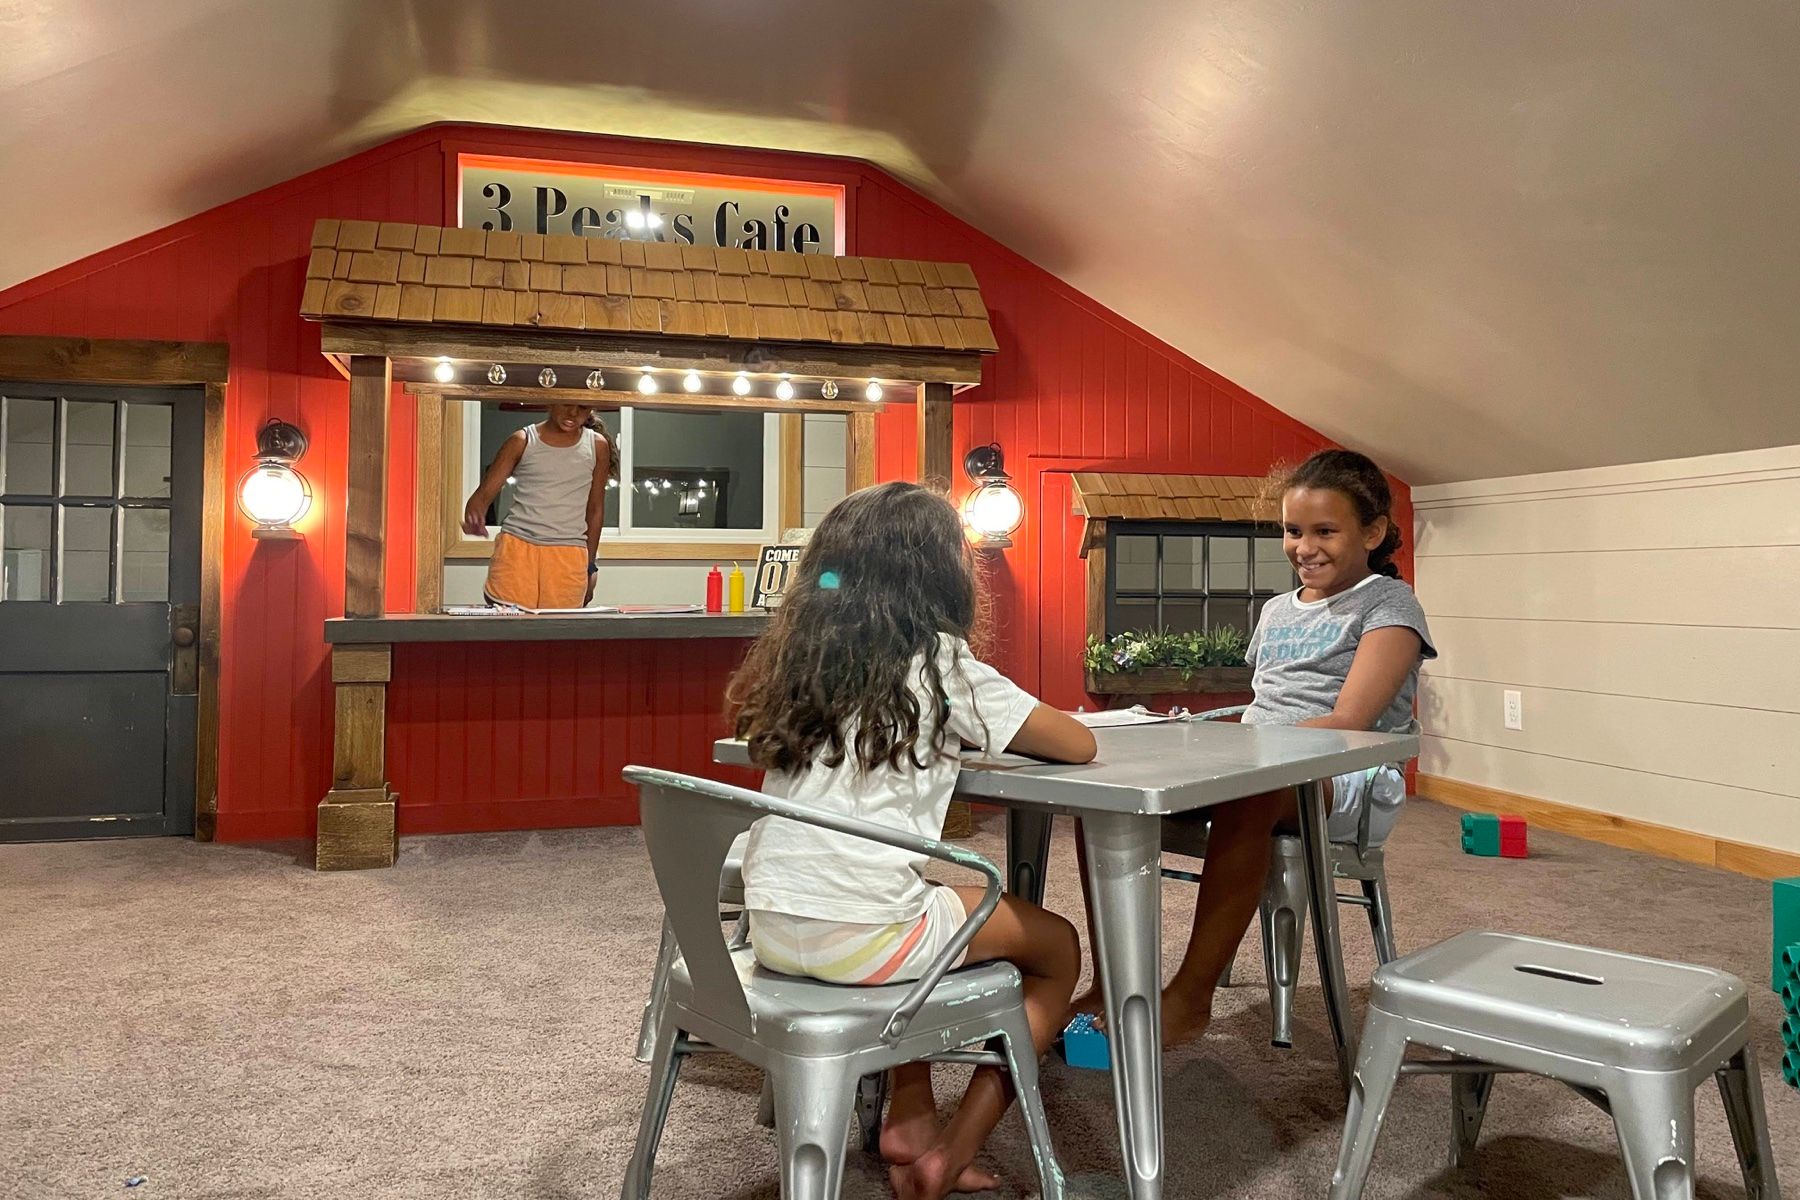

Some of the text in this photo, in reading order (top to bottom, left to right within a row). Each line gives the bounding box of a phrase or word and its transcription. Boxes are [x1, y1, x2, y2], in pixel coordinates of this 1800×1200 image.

[482, 182, 513, 232] 3
[714, 200, 820, 255] Cafe
[765, 549, 799, 562] COME
